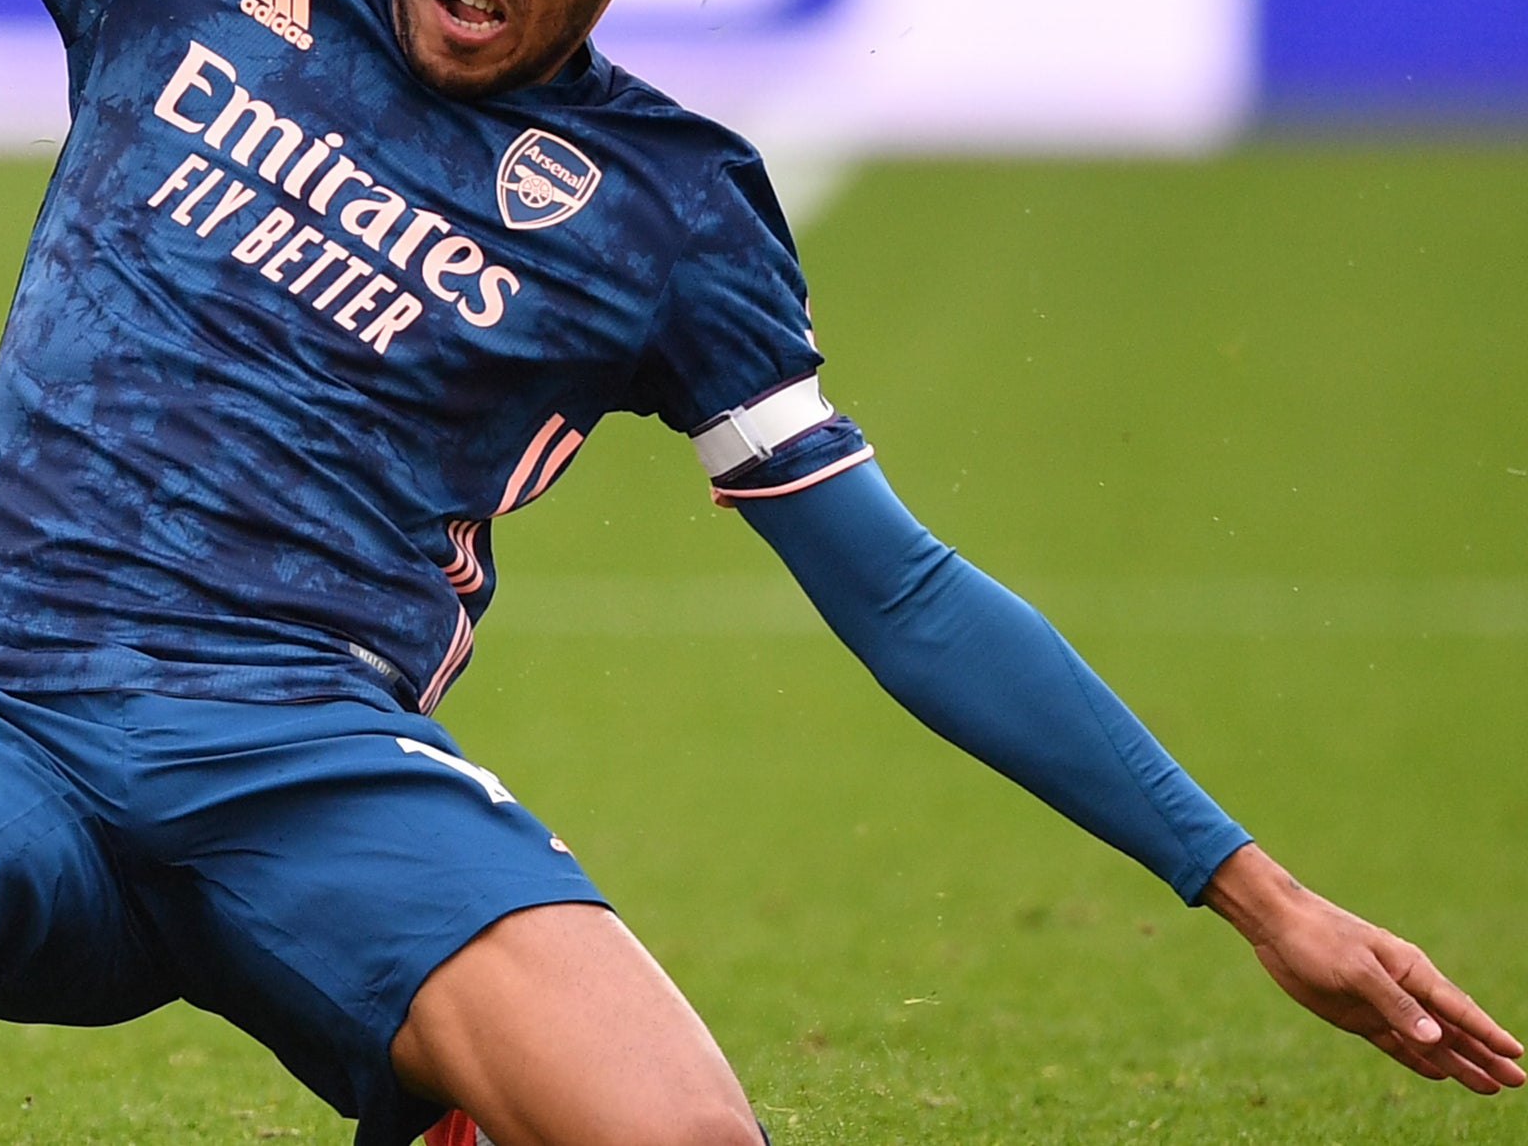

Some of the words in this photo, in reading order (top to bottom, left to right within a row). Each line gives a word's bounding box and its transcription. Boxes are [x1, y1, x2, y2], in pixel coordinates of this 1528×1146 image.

[146, 152, 257, 239] FLY
[230, 205, 425, 356] BETTER
[152, 39, 522, 329] Emirates
[523, 144, 587, 192] Arsenal
